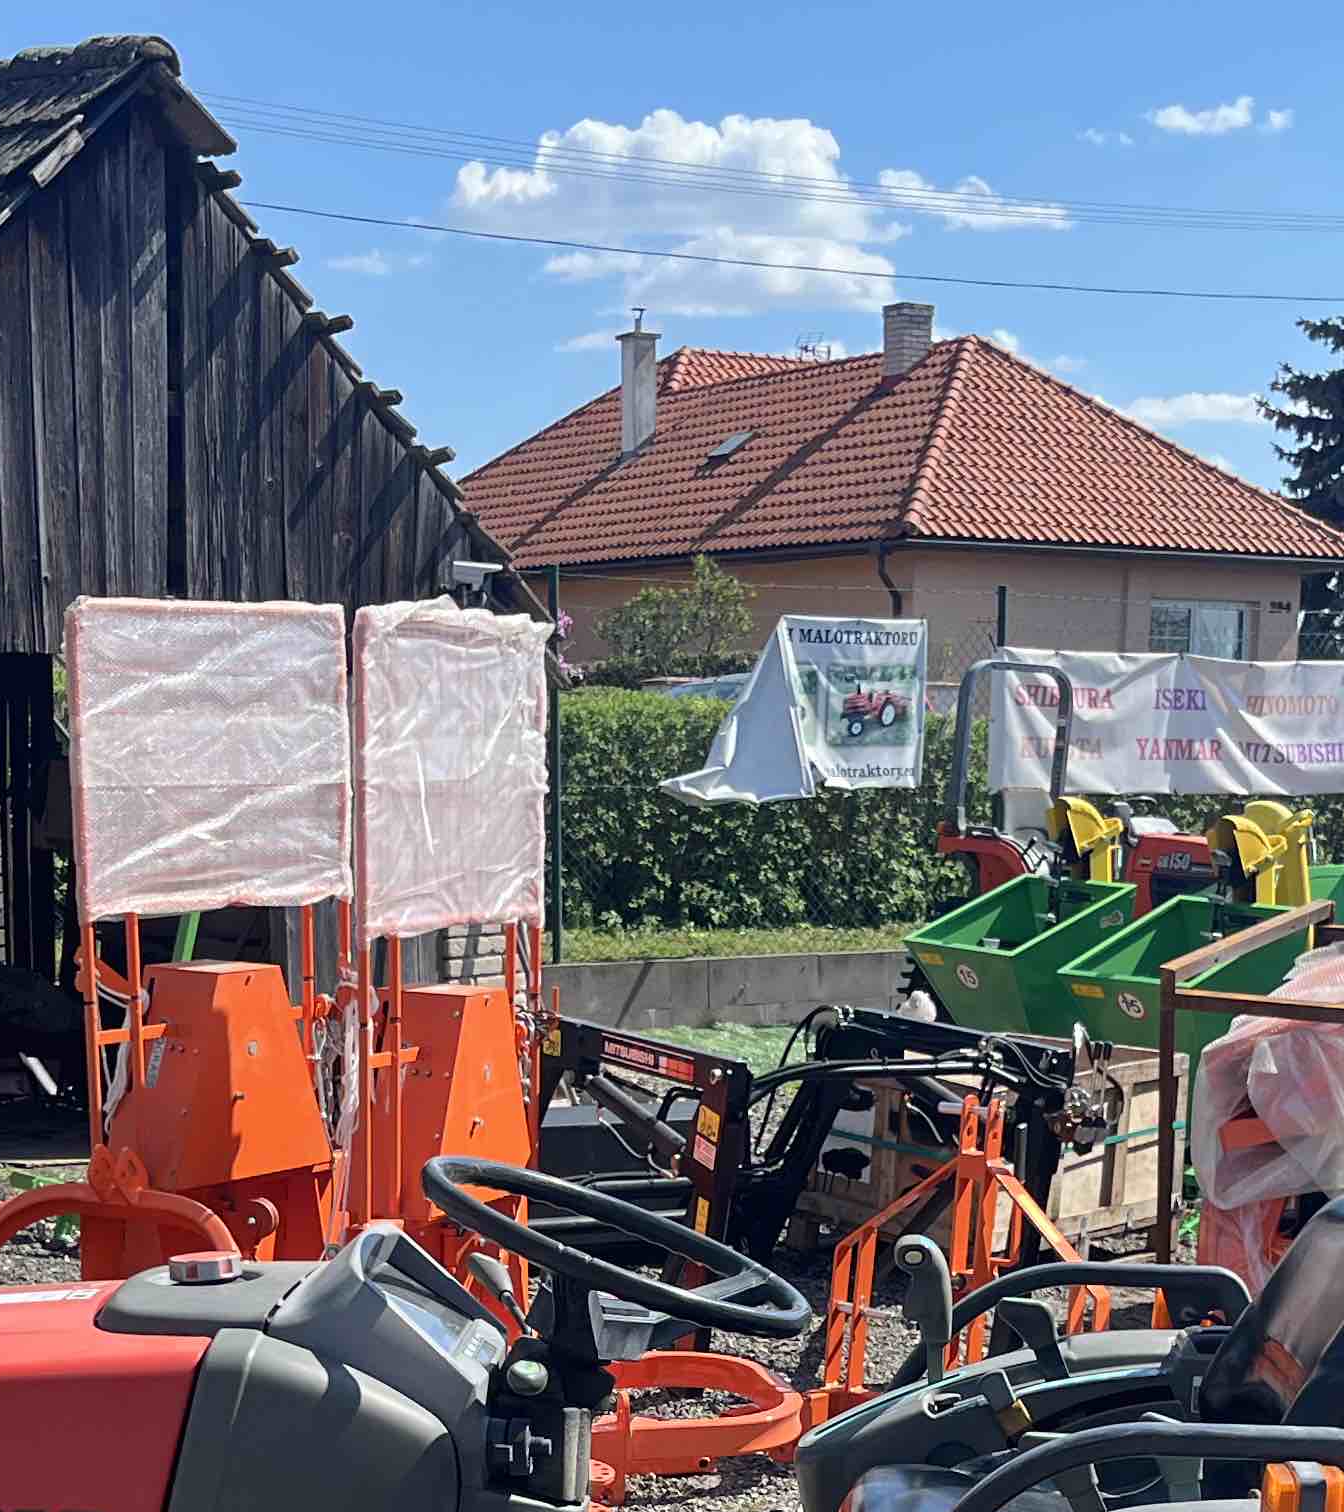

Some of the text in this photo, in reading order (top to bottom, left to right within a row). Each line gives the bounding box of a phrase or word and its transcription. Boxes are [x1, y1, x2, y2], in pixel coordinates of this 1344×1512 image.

[1015, 684, 1115, 710] SHIBURA
[1154, 688, 1206, 711] ISEKI
[1136, 738, 1223, 761] YANMAR
[1235, 741, 1344, 764] MITSUBISHI
